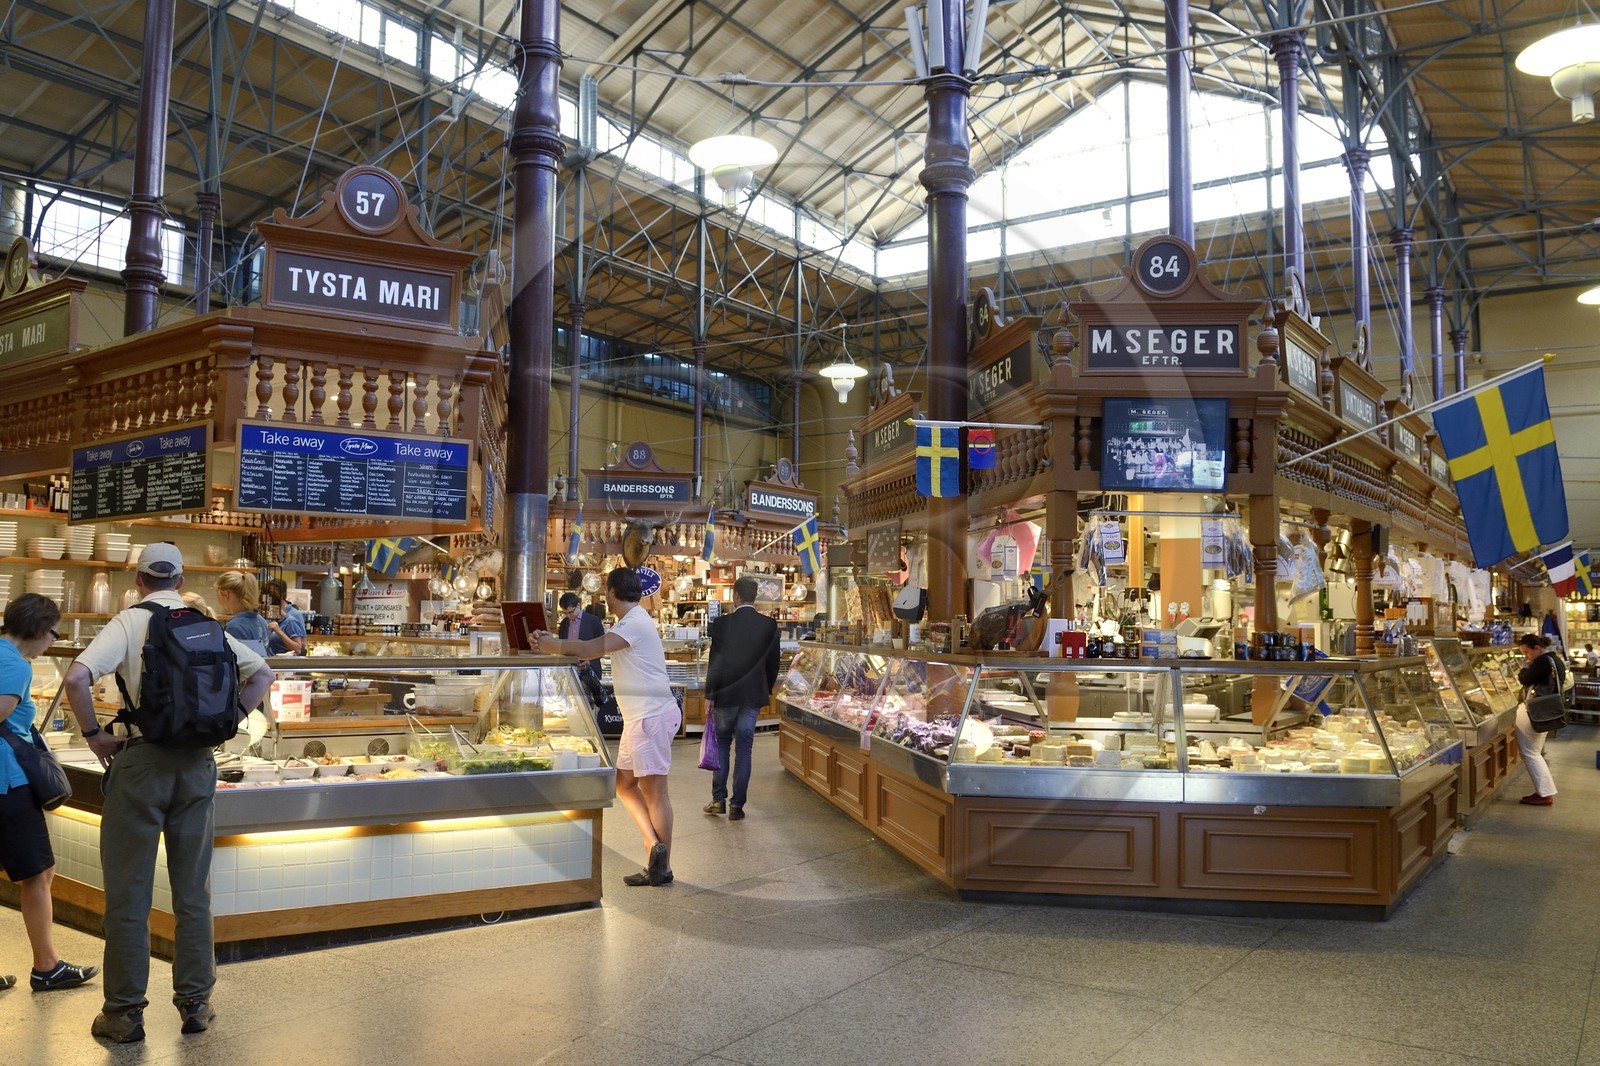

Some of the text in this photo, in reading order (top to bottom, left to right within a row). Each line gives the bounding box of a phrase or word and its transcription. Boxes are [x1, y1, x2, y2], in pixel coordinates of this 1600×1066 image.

[356, 191, 386, 217] 57
[1150, 255, 1180, 278] 84
[288, 267, 440, 311] TYSTA MARI
[22, 322, 46, 348] MARI
[1142, 355, 1183, 365] EFTR.
[160, 435, 192, 450] Take away
[260, 430, 325, 451] Take away
[86, 449, 114, 462] Take away
[394, 442, 454, 461] Take away
[633, 449, 646, 460] 88
